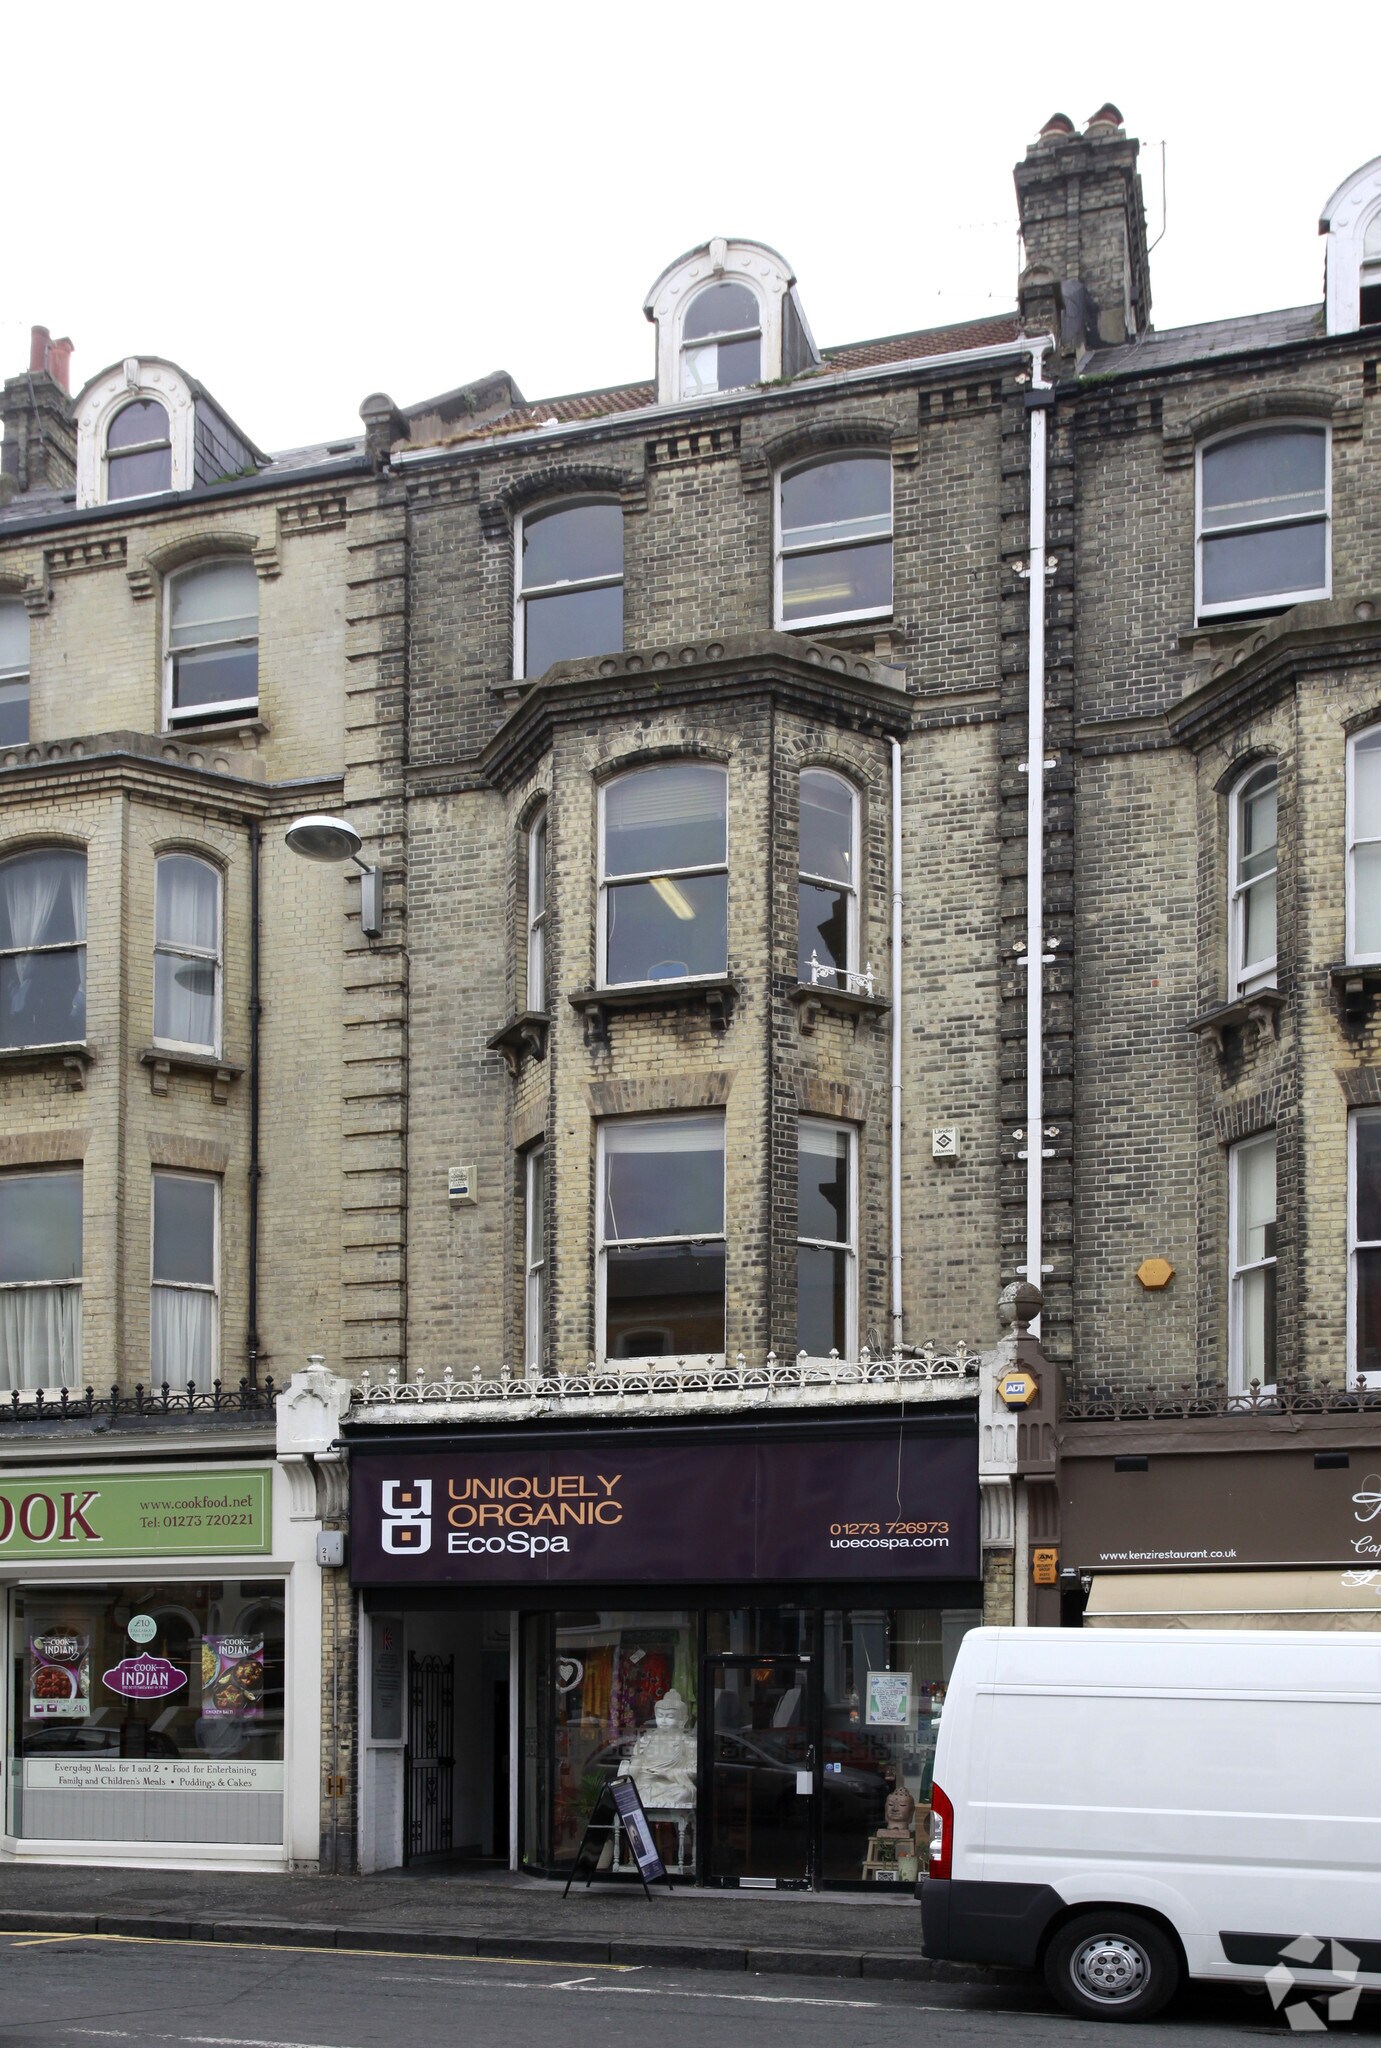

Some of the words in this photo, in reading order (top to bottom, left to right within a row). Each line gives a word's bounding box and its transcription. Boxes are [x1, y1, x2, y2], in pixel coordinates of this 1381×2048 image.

[1006, 1384, 1024, 1392] ADT
[448, 1474, 622, 1500] UNIQUELY
[139, 1494, 253, 1511] www.cookfood.net
[140, 1516, 161, 1528] Tel:
[163, 1515, 202, 1528] 01273
[205, 1514, 253, 1526] 720221
[447, 1501, 623, 1528] ORGANIC
[830, 1523, 880, 1535] 01273
[885, 1521, 949, 1534] 726973
[447, 1531, 570, 1558] EcoSpa
[830, 1537, 949, 1550] uoecospa.com
[1100, 1549, 1237, 1561] www.kenzirestaurant.co.uk
[134, 1619, 151, 1628] £10
[50, 1638, 70, 1646] COOK
[224, 1638, 245, 1646] COOK
[45, 1645, 74, 1654] INDIAN
[218, 1645, 249, 1654] INDIAN
[133, 1663, 157, 1672] COOK
[121, 1672, 169, 1686] INDIAN
[72, 1704, 87, 1712] £10
[54, 1763, 91, 1774] Everyday
[93, 1763, 116, 1773] Meals
[118, 1764, 130, 1773] for
[132, 1764, 136, 1773] 1
[137, 1764, 152, 1773] and
[153, 1764, 160, 1774] 2
[172, 1765, 191, 1774] Food
[193, 1765, 205, 1774] for
[206, 1765, 257, 1777] Entertaining
[58, 1776, 84, 1787] Family
[85, 1776, 99, 1786] and
[100, 1776, 141, 1786] Children's
[142, 1776, 166, 1786] Meals
[179, 1777, 216, 1789] Puddings
[217, 1778, 226, 1787] &
[227, 1778, 252, 1788] Cakes
